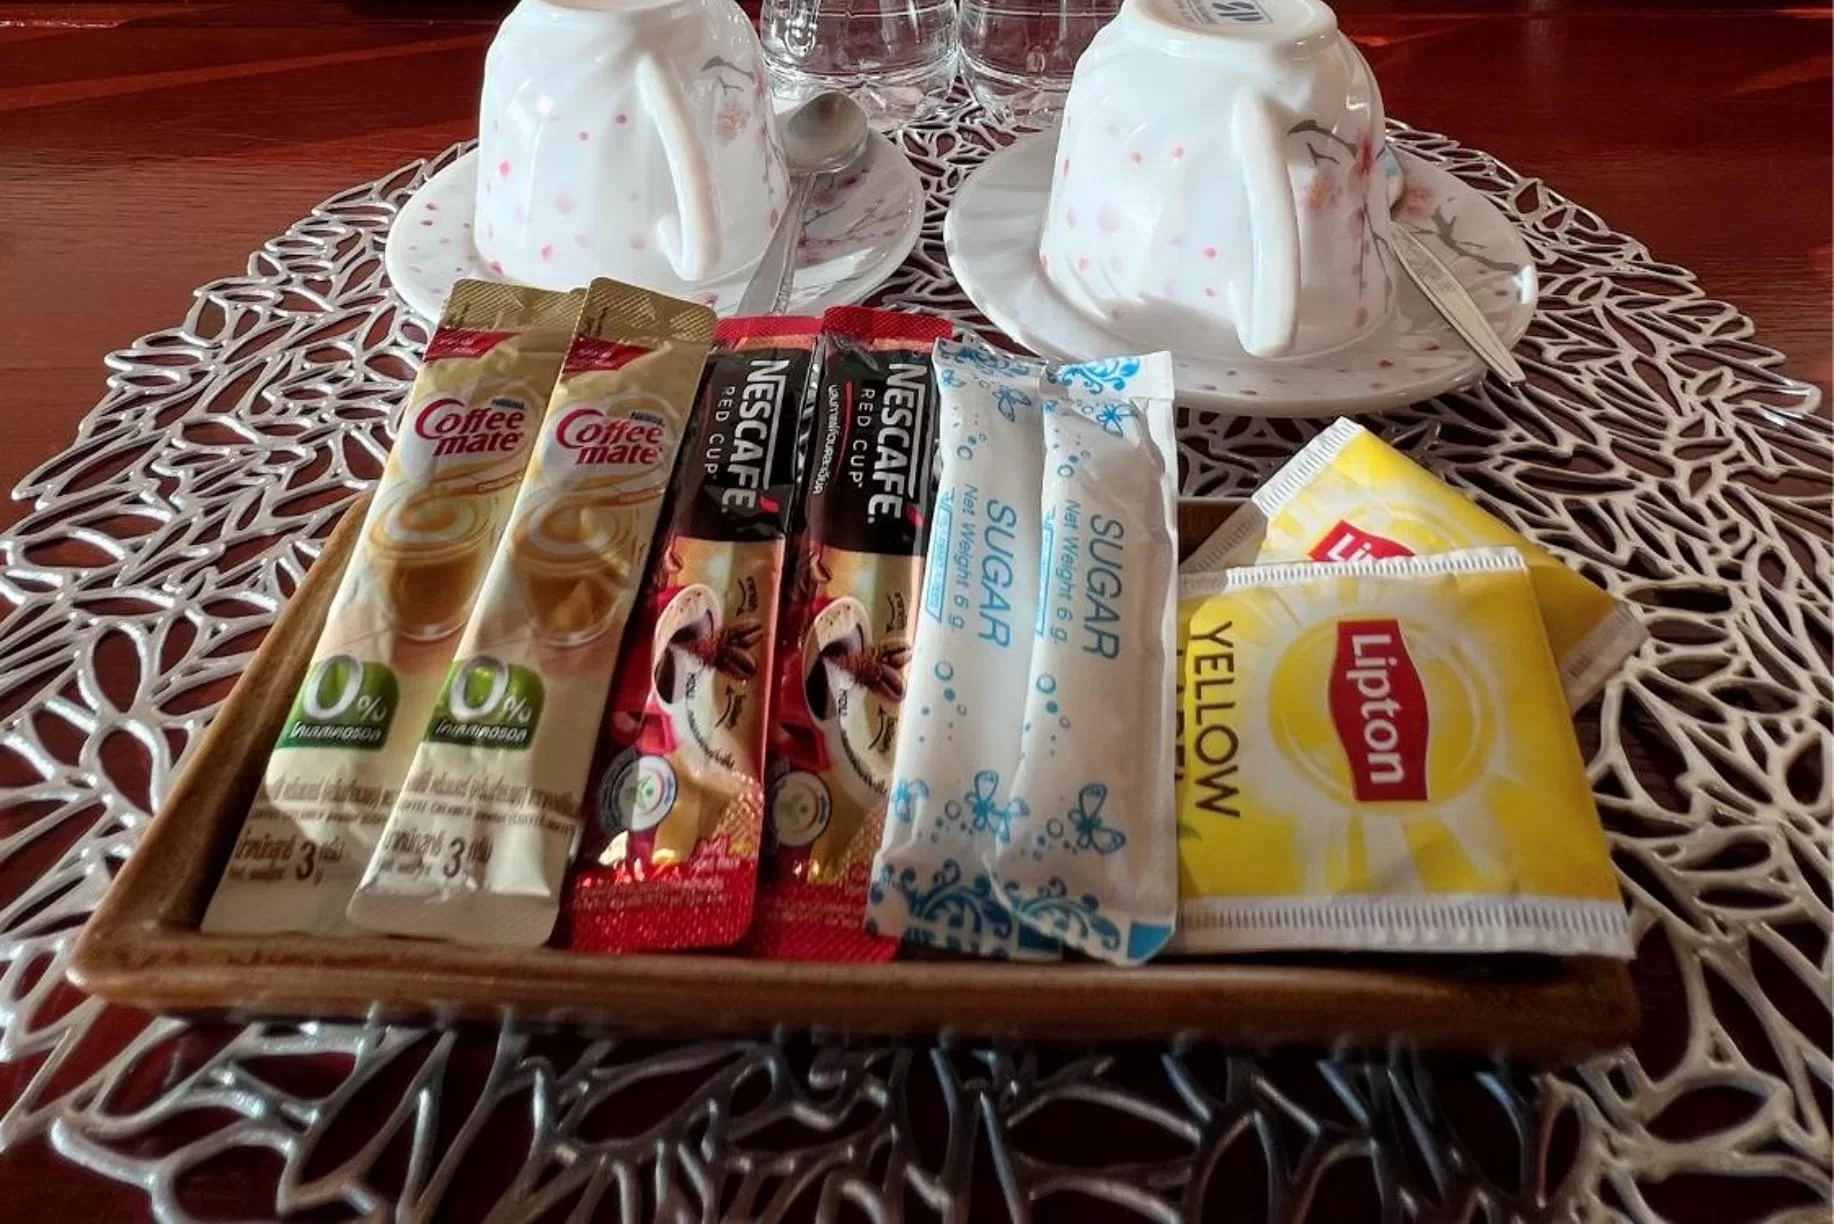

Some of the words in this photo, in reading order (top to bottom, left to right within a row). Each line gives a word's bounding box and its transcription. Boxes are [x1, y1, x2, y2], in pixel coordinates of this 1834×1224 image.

[415, 398, 525, 440] Coffee
[715, 385, 737, 422] RED
[857, 388, 876, 427] RED
[433, 431, 523, 456] mate
[556, 409, 664, 450] Coffee
[576, 443, 662, 465] mate
[704, 433, 725, 475] CUP
[849, 439, 869, 483] CUP
[962, 484, 979, 516] Net
[1063, 499, 1081, 525] Net
[953, 523, 976, 588] Weight
[977, 499, 1018, 647] SUGAR
[1055, 536, 1080, 601] Weight
[954, 594, 969, 609] 6
[1082, 514, 1125, 660] SUGAR
[1056, 607, 1073, 622] 6
[304, 655, 388, 723] 0%
[451, 655, 533, 724] 0%
[1346, 634, 1405, 785] Lipton
[1190, 621, 1241, 818] YELLOW
[296, 841, 318, 882] 3
[443, 836, 466, 878] 3
